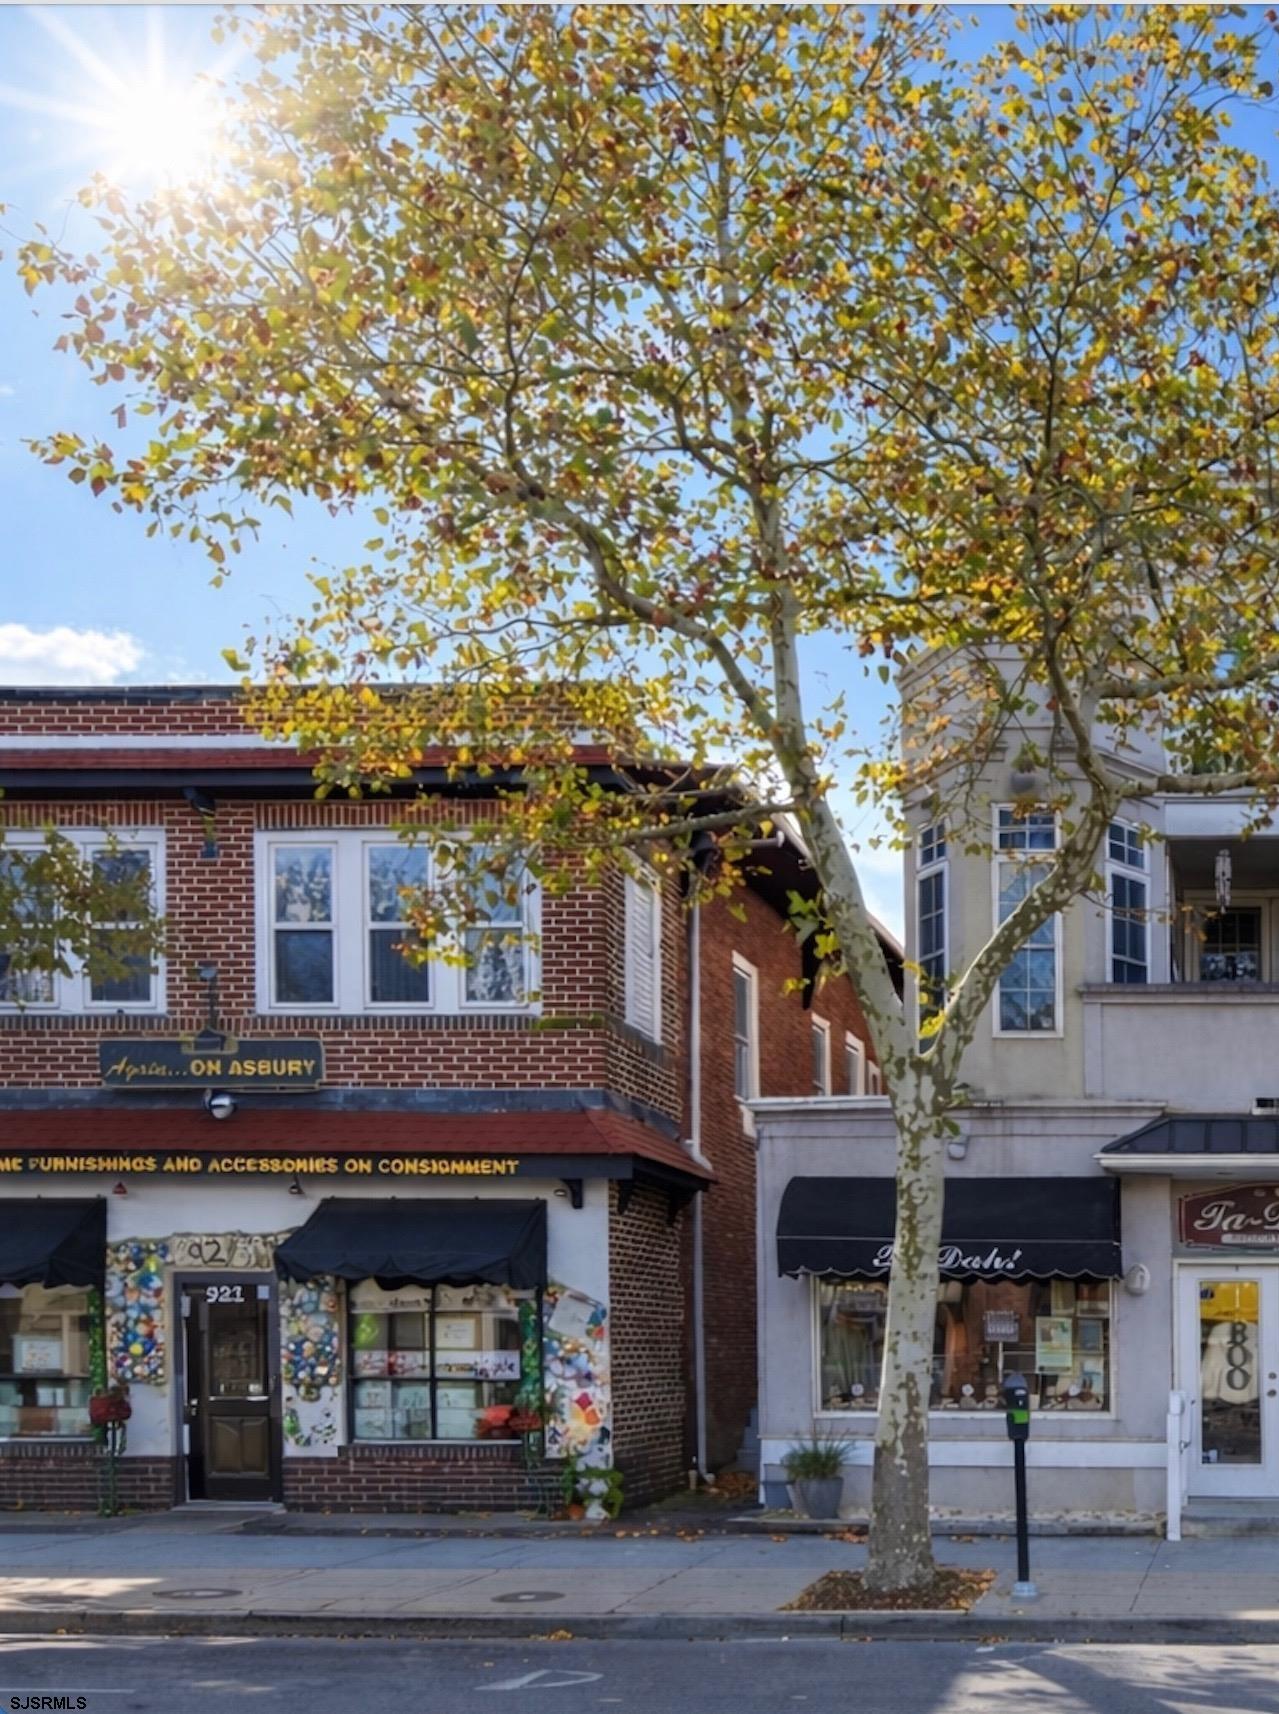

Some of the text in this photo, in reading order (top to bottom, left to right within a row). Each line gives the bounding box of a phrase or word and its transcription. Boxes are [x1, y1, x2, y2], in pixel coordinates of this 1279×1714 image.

[190, 1059, 221, 1076] ON
[228, 1059, 315, 1076] ASBURY
[163, 1157, 201, 1172] AND
[344, 1158, 372, 1173] ON
